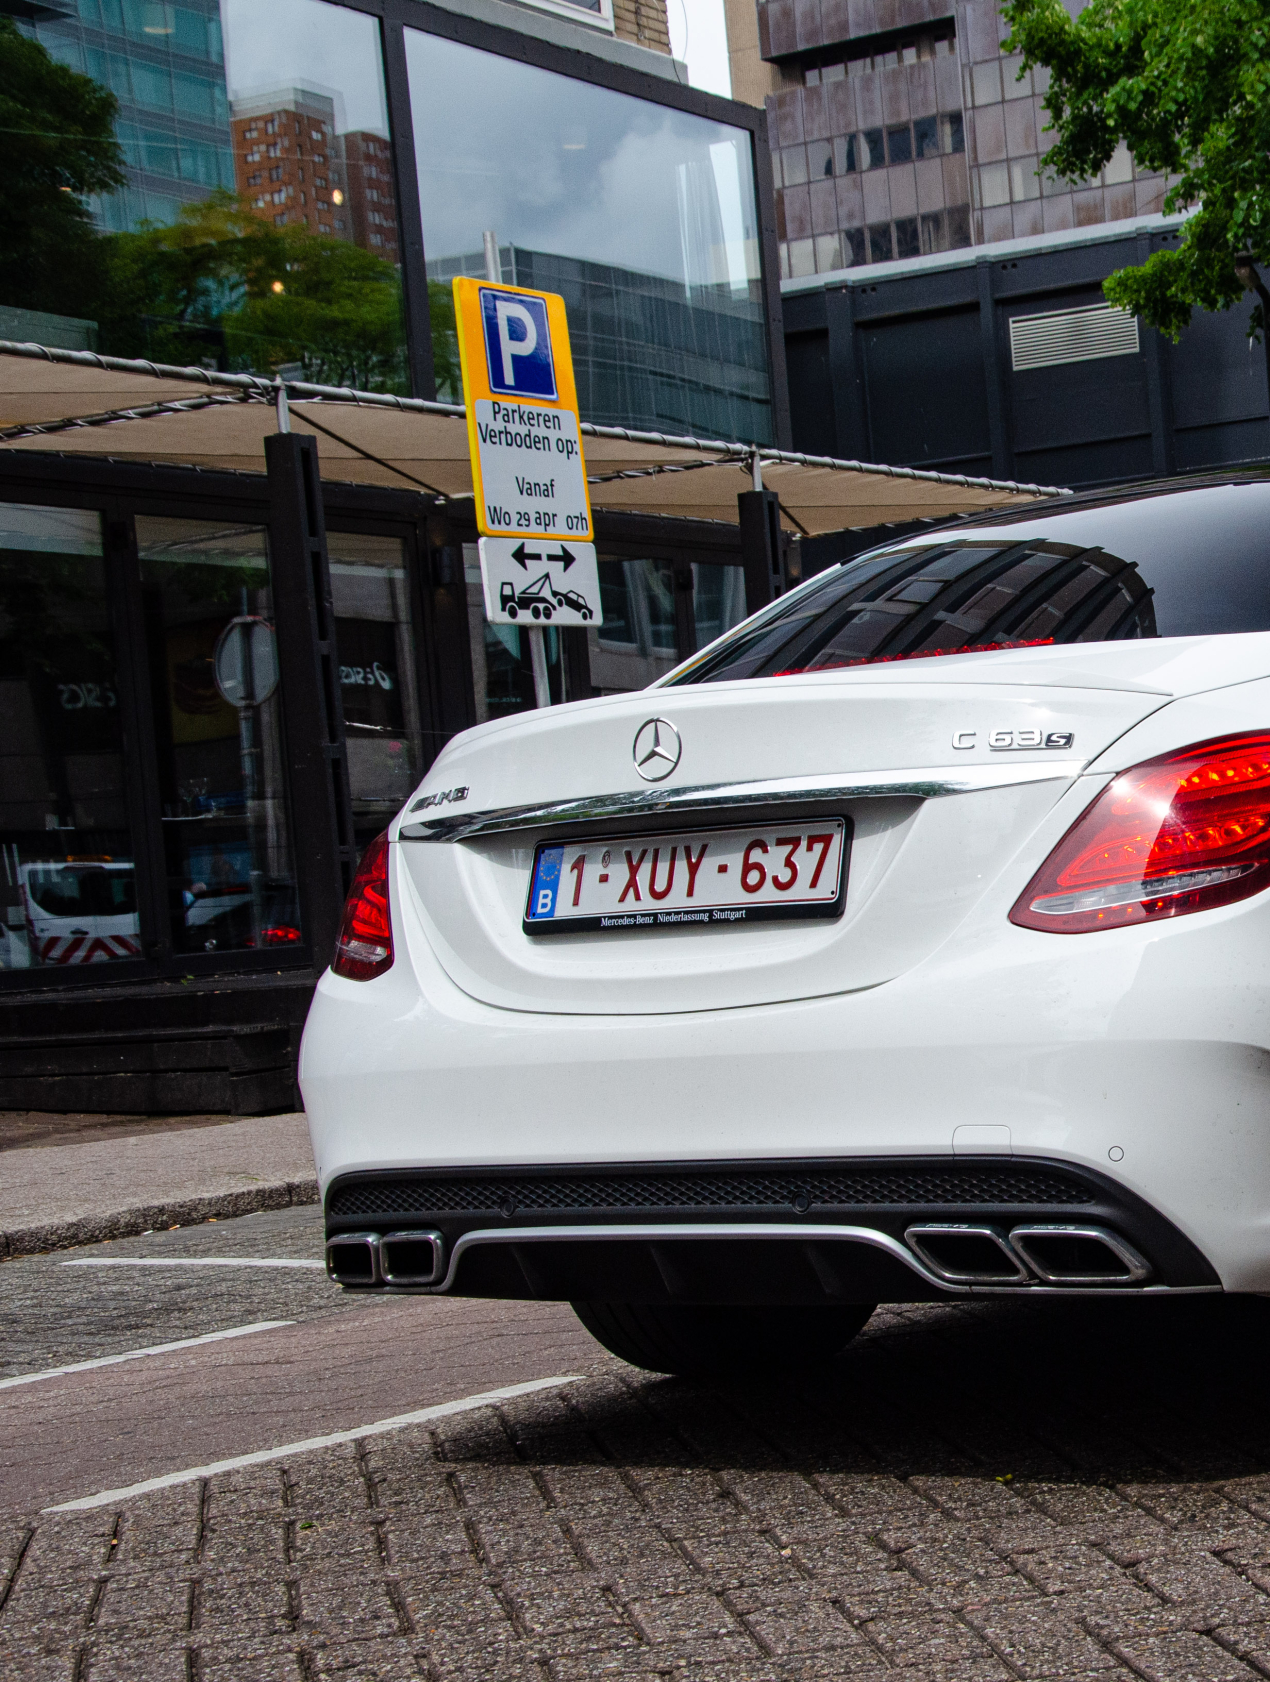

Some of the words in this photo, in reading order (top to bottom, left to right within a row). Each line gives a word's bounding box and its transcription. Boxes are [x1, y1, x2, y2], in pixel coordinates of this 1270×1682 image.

[495, 300, 537, 386] P
[491, 401, 561, 431] Parkeren
[477, 422, 551, 452] Verboden
[555, 438, 578, 460] op:
[515, 476, 555, 498] Vanaf
[487, 505, 511, 526] Wo
[516, 511, 530, 527] 29
[534, 511, 557, 532] apr
[566, 512, 588, 531] 07h
[952, 731, 976, 750] C
[536, 889, 553, 914] B
[600, 915, 654, 927] Mercedes-Benz
[657, 911, 709, 922] Niederlassung
[712, 909, 746, 920] Stuttgart
